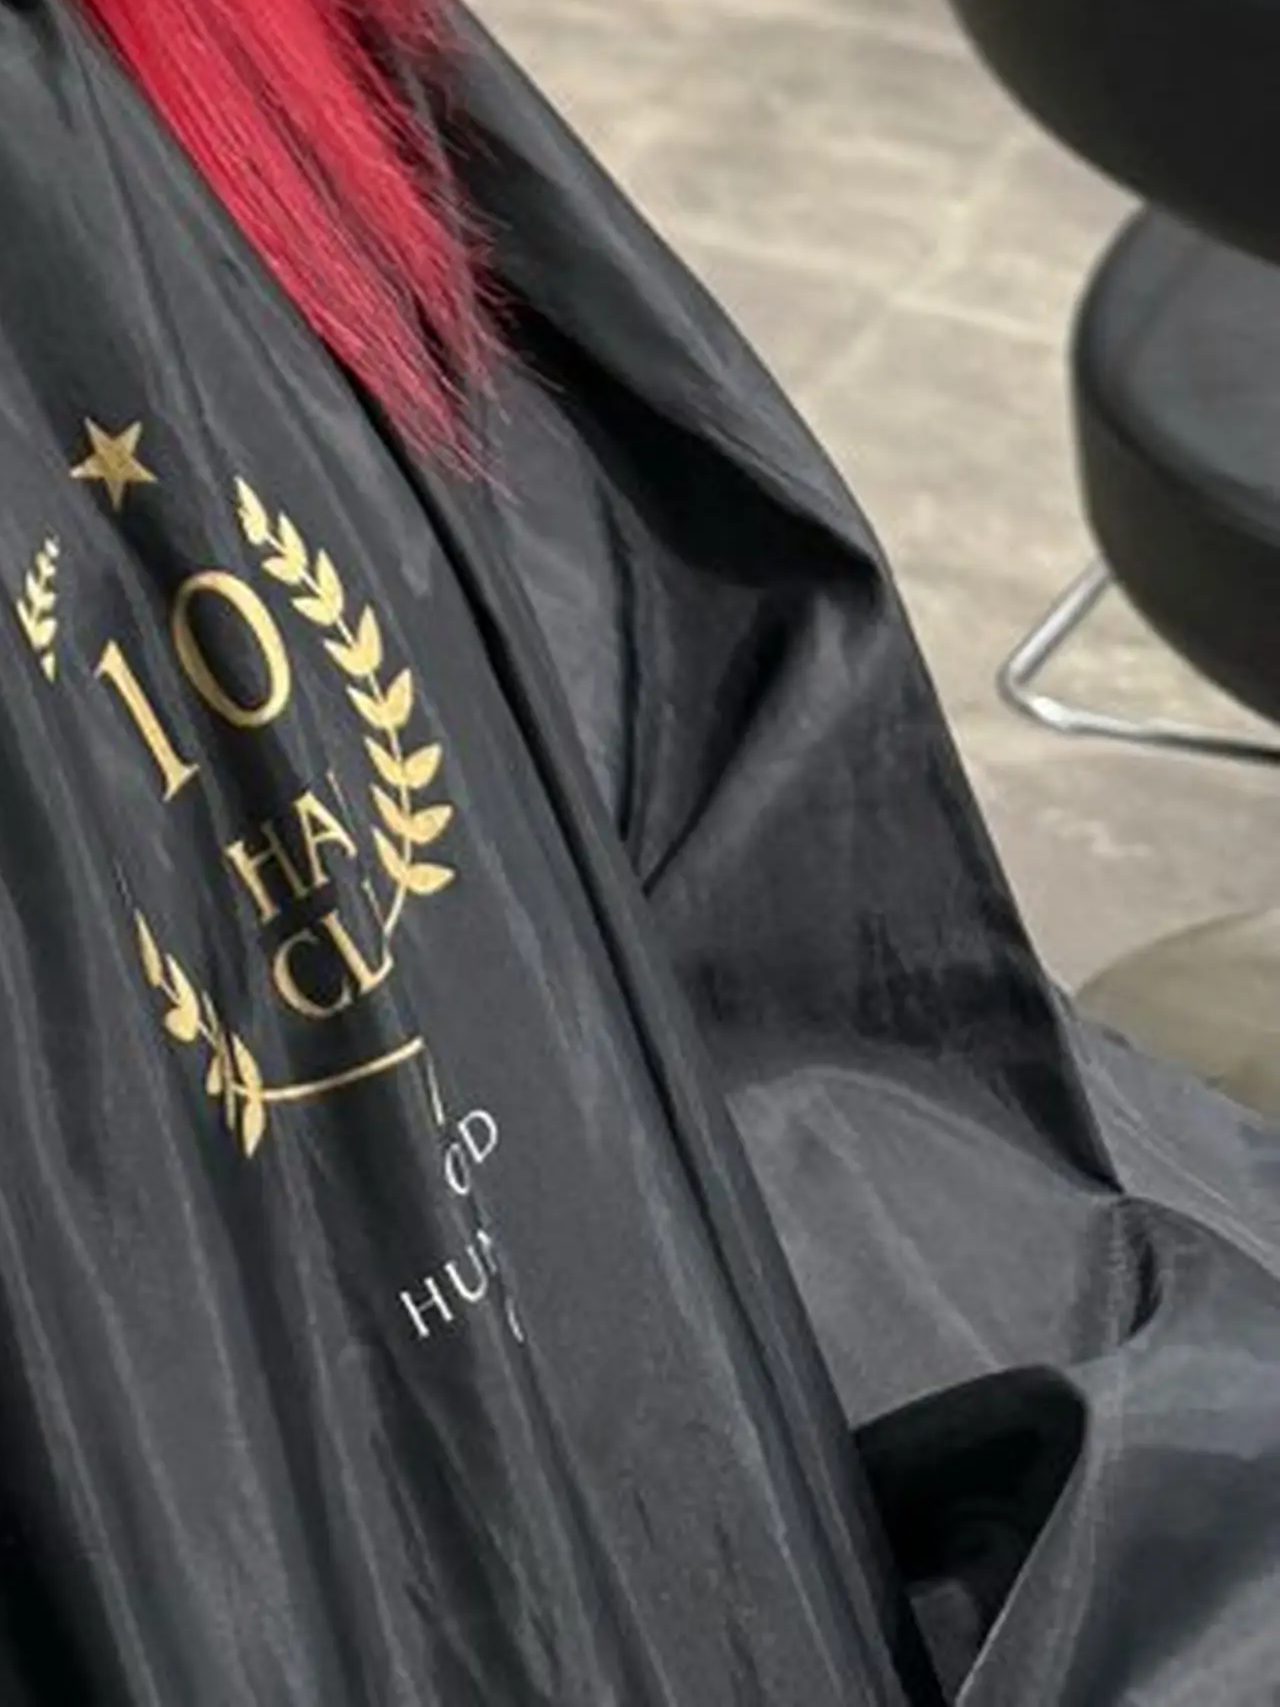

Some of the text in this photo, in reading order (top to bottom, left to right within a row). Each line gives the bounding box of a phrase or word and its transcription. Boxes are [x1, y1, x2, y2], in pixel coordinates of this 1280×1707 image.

[93, 569, 292, 803] 10
[225, 769, 358, 925] HA
[273, 881, 394, 1018] CL
